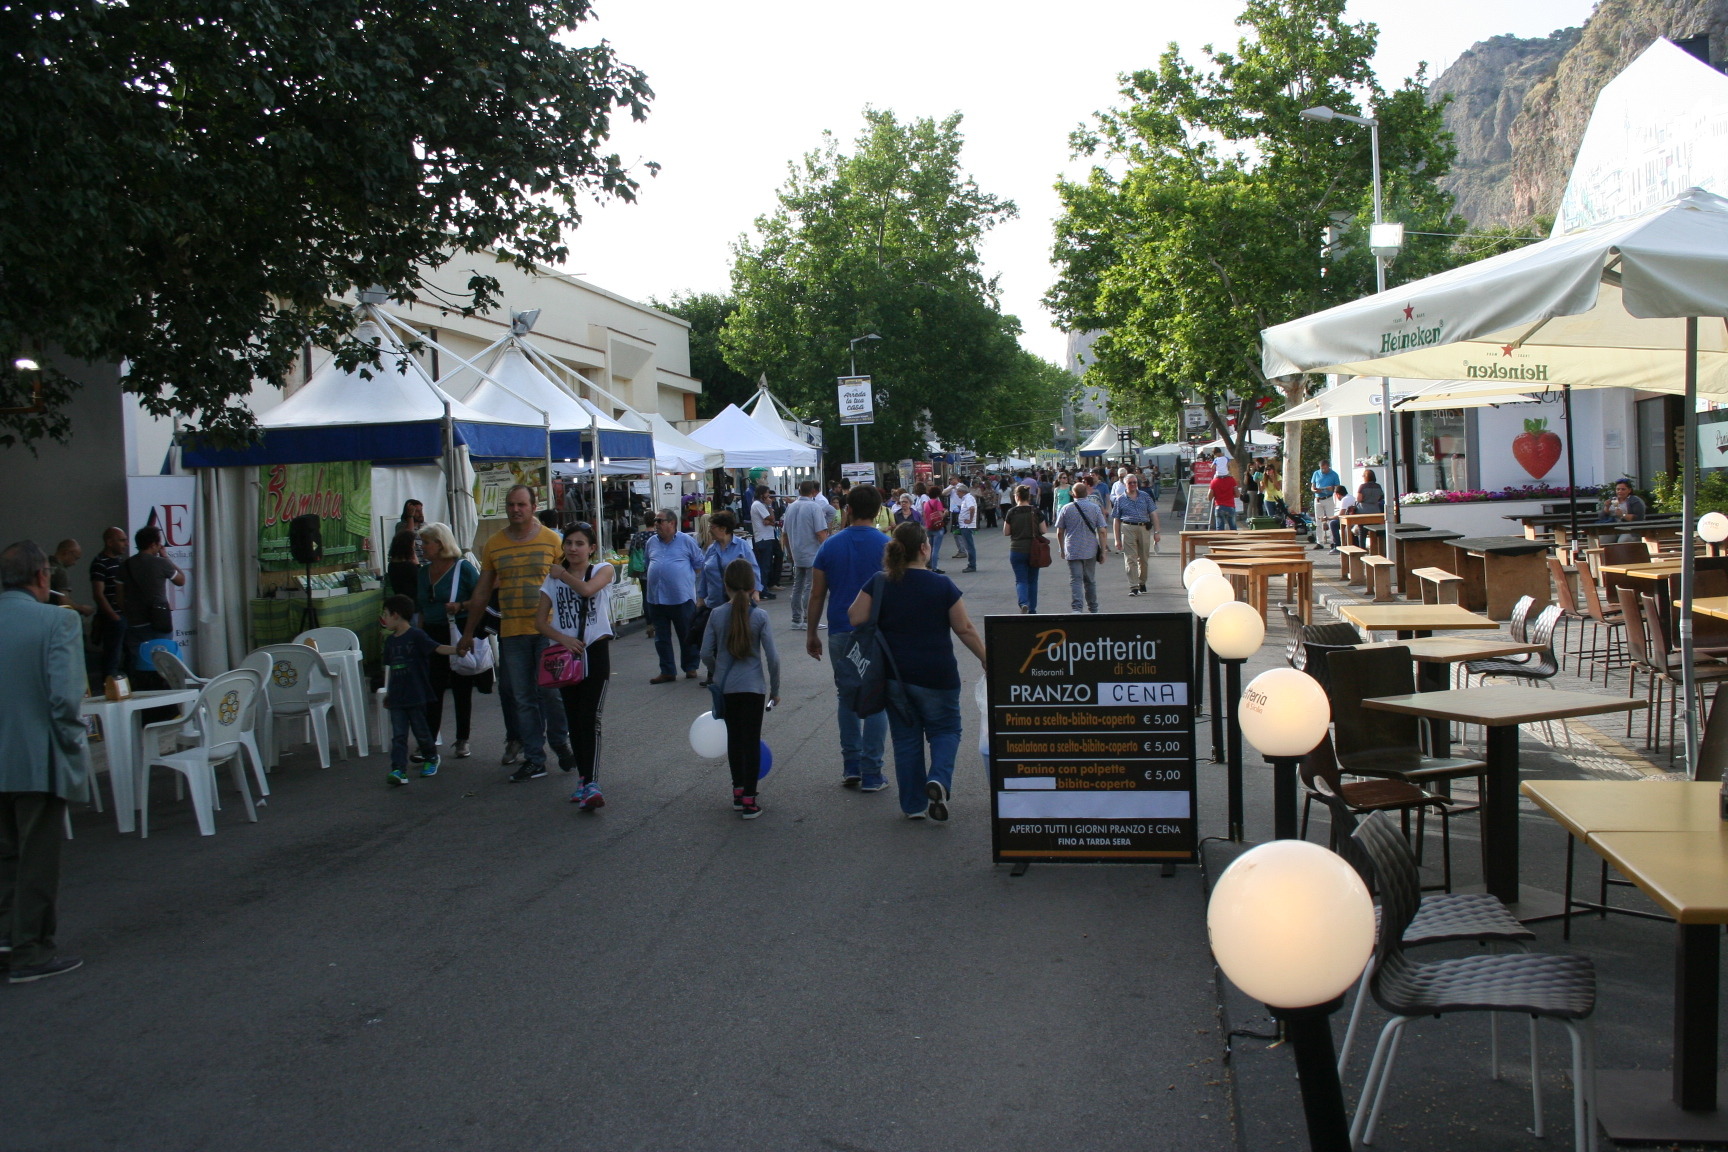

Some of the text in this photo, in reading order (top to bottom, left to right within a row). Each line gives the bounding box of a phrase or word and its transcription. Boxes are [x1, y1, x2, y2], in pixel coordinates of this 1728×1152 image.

[1379, 327, 1441, 353] Heineken
[557, 597, 596, 616] BEFOE
[1019, 628, 1156, 676] Polpetteria
[1031, 668, 1064, 677] Ristoranti
[1113, 662, 1157, 675] di Sicilia
[1010, 684, 1091, 703] PRANZO
[1112, 684, 1175, 703] CENA
[1005, 712, 1180, 728] Primo a scelta-bibita-coperto € 5,00
[1006, 740, 1048, 753] Insalatona
[1050, 743, 1056, 752] a
[1144, 742, 1152, 752] €
[1154, 741, 1180, 753] 5,00
[1017, 763, 1181, 782] Panino con polpette € 5,00
[1009, 825, 1043, 835] APERTO
[1045, 825, 1068, 834] TUTTI
[1075, 825, 1108, 834] GIORNI
[1110, 825, 1146, 834] PRANZO
[1149, 825, 1154, 834] E
[1156, 825, 1181, 834] CENA
[1058, 837, 1131, 846] FINO A TARDA SERA
